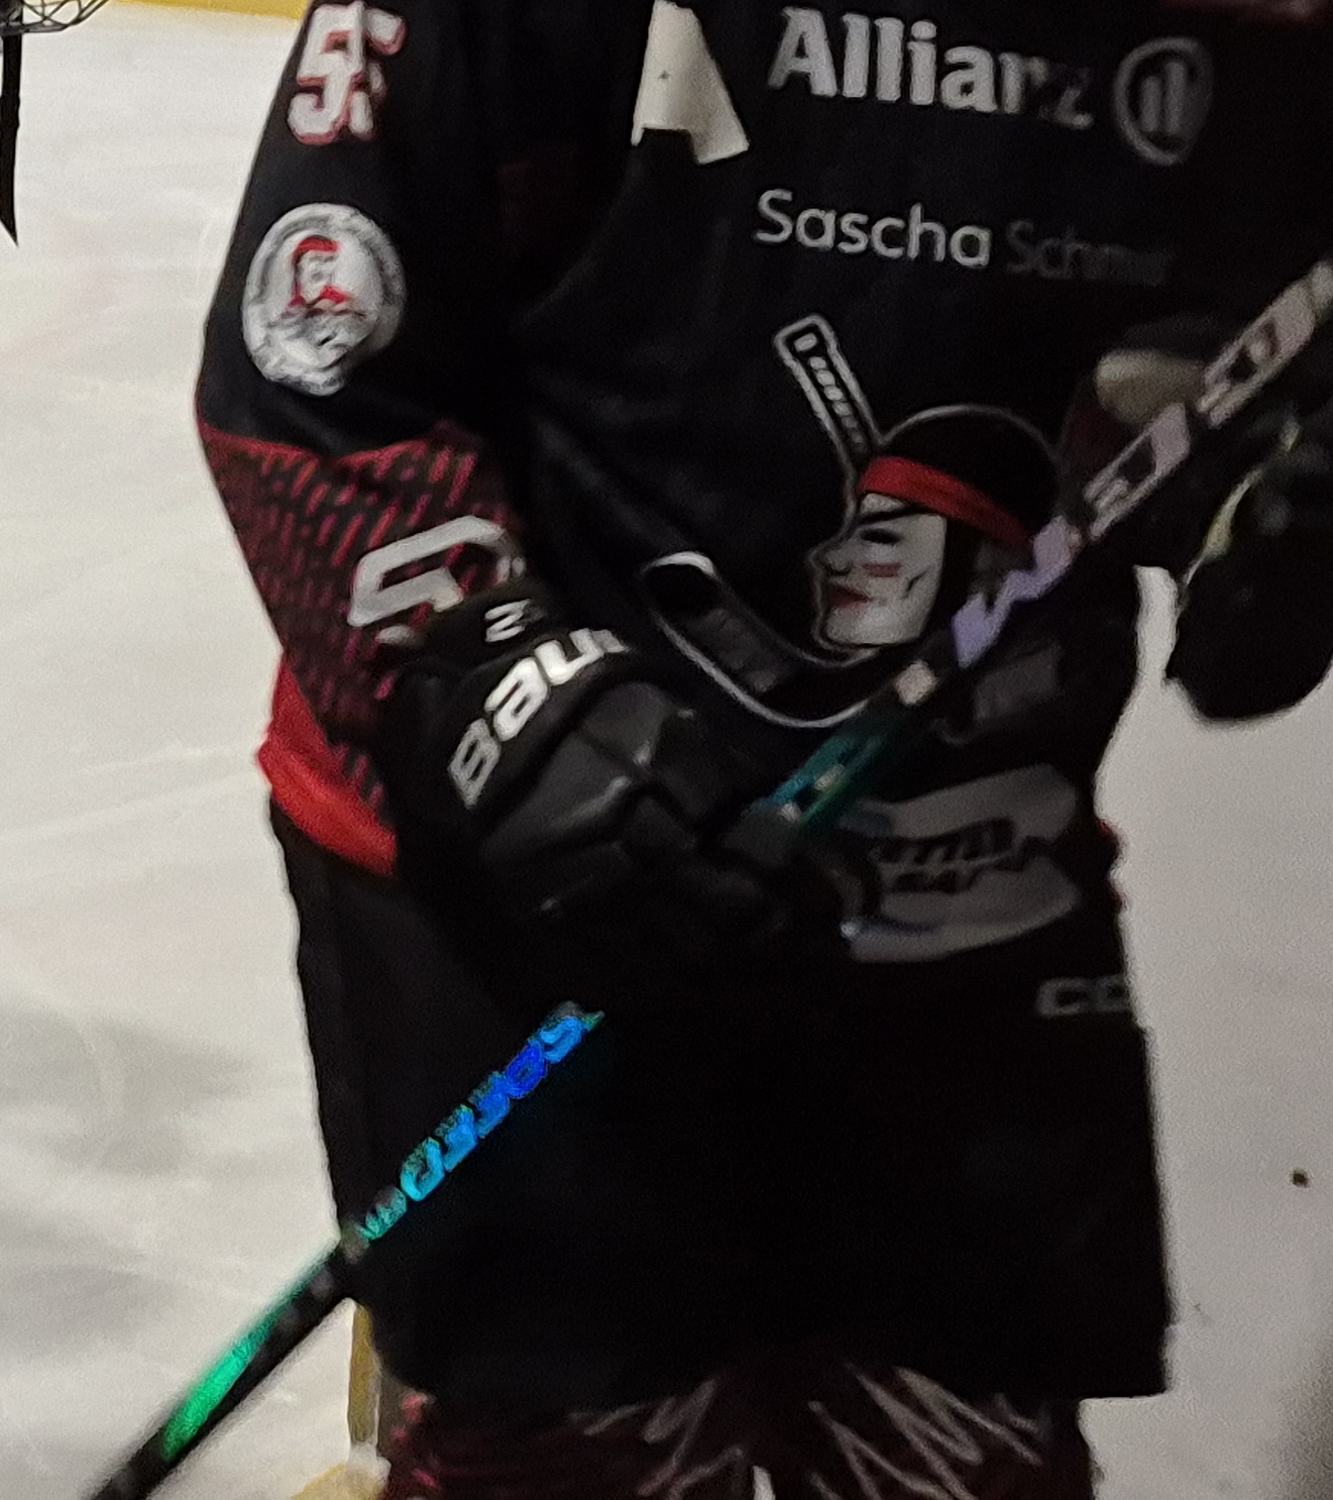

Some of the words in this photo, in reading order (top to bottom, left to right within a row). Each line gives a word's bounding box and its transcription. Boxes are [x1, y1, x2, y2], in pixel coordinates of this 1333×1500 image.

[766, 4, 1097, 131] Allianz
[751, 187, 995, 271] Sascha
[446, 627, 631, 812] Bau
